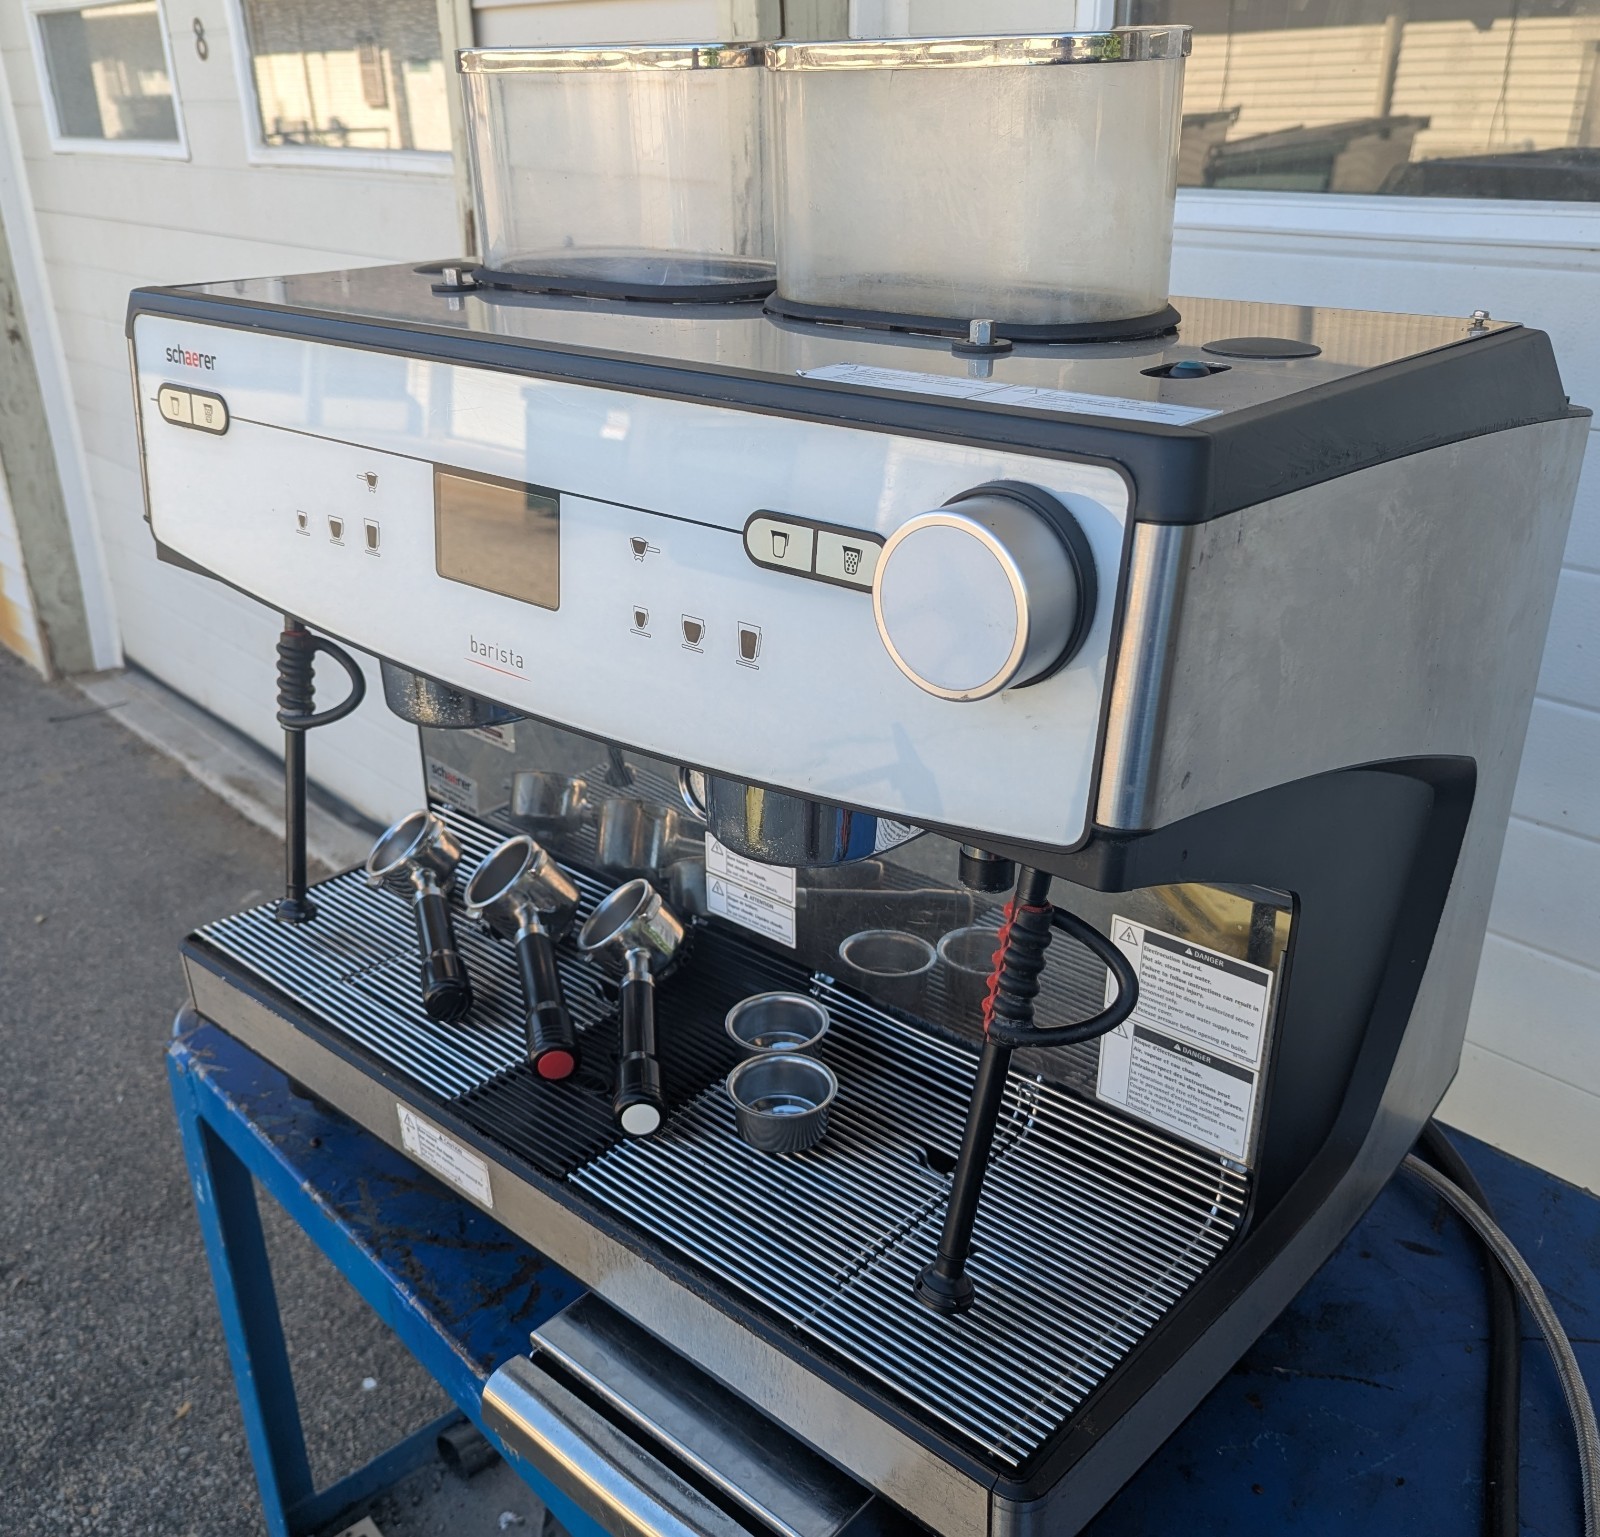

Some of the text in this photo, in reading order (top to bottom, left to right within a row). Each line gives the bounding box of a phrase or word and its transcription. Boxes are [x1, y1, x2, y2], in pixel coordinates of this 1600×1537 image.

[193, 17, 208, 61] 8
[166, 344, 216, 370] schaerer
[470, 635, 524, 669] barista
[431, 763, 472, 791] schaerer
[749, 894, 773, 909] ATTENTION
[1142, 954, 1211, 985] Hot air, steam and water.
[1143, 945, 1202, 972] Electrocution hazard.
[1193, 950, 1224, 967] DANGER
[1141, 970, 1156, 980] death
[1165, 979, 1185, 991] serious
[1186, 987, 1204, 999] injury.
[1141, 963, 1160, 974] Failure
[1169, 973, 1186, 984] follow
[1187, 980, 1221, 998] instructions
[1222, 993, 1233, 1002] can
[1234, 998, 1251, 1009] result
[1157, 985, 1174, 996] should
[1175, 992, 1182, 1000] be
[1183, 995, 1196, 1005] done
[1197, 1000, 1204, 1008] by
[1205, 1003, 1234, 1020] authorized
[1235, 1015, 1254, 1028] service
[1157, 1007, 1173, 1017] cover.
[1167, 1003, 1183, 1015] power
[1184, 1010, 1194, 1019] and
[1196, 1015, 1211, 1025] water
[1212, 1021, 1229, 1033] supply
[1230, 1028, 1248, 1040] before
[1133, 1037, 1150, 1049] Risque
[1137, 1006, 1247, 1055] Release pressure before opening the boiler.
[1143, 1050, 1162, 1062] vapeur
[1170, 1061, 1180, 1070] eau
[1181, 1066, 1202, 1079] chaude.
[1182, 1046, 1211, 1064] DANGER
[1130, 1075, 1138, 1083] par
[1144, 1081, 1169, 1096] personnel
[1132, 1053, 1230, 1100] Le non-respect des instructions peut
[1129, 1081, 1147, 1093] Couper
[1154, 1092, 1174, 1105] machine
[1218, 1120, 1225, 1128] en
[1226, 1123, 1236, 1132] eau
[1163, 1074, 1176, 1084] mort
[1177, 1080, 1185, 1088] ou
[1186, 1083, 1196, 1093] des
[1197, 1088, 1222, 1104] blessures
[1223, 1099, 1243, 1113] graves.
[1164, 1083, 1174, 1092] doit
[1175, 1087, 1185, 1097] être
[1212, 1103, 1244, 1122] uniquement
